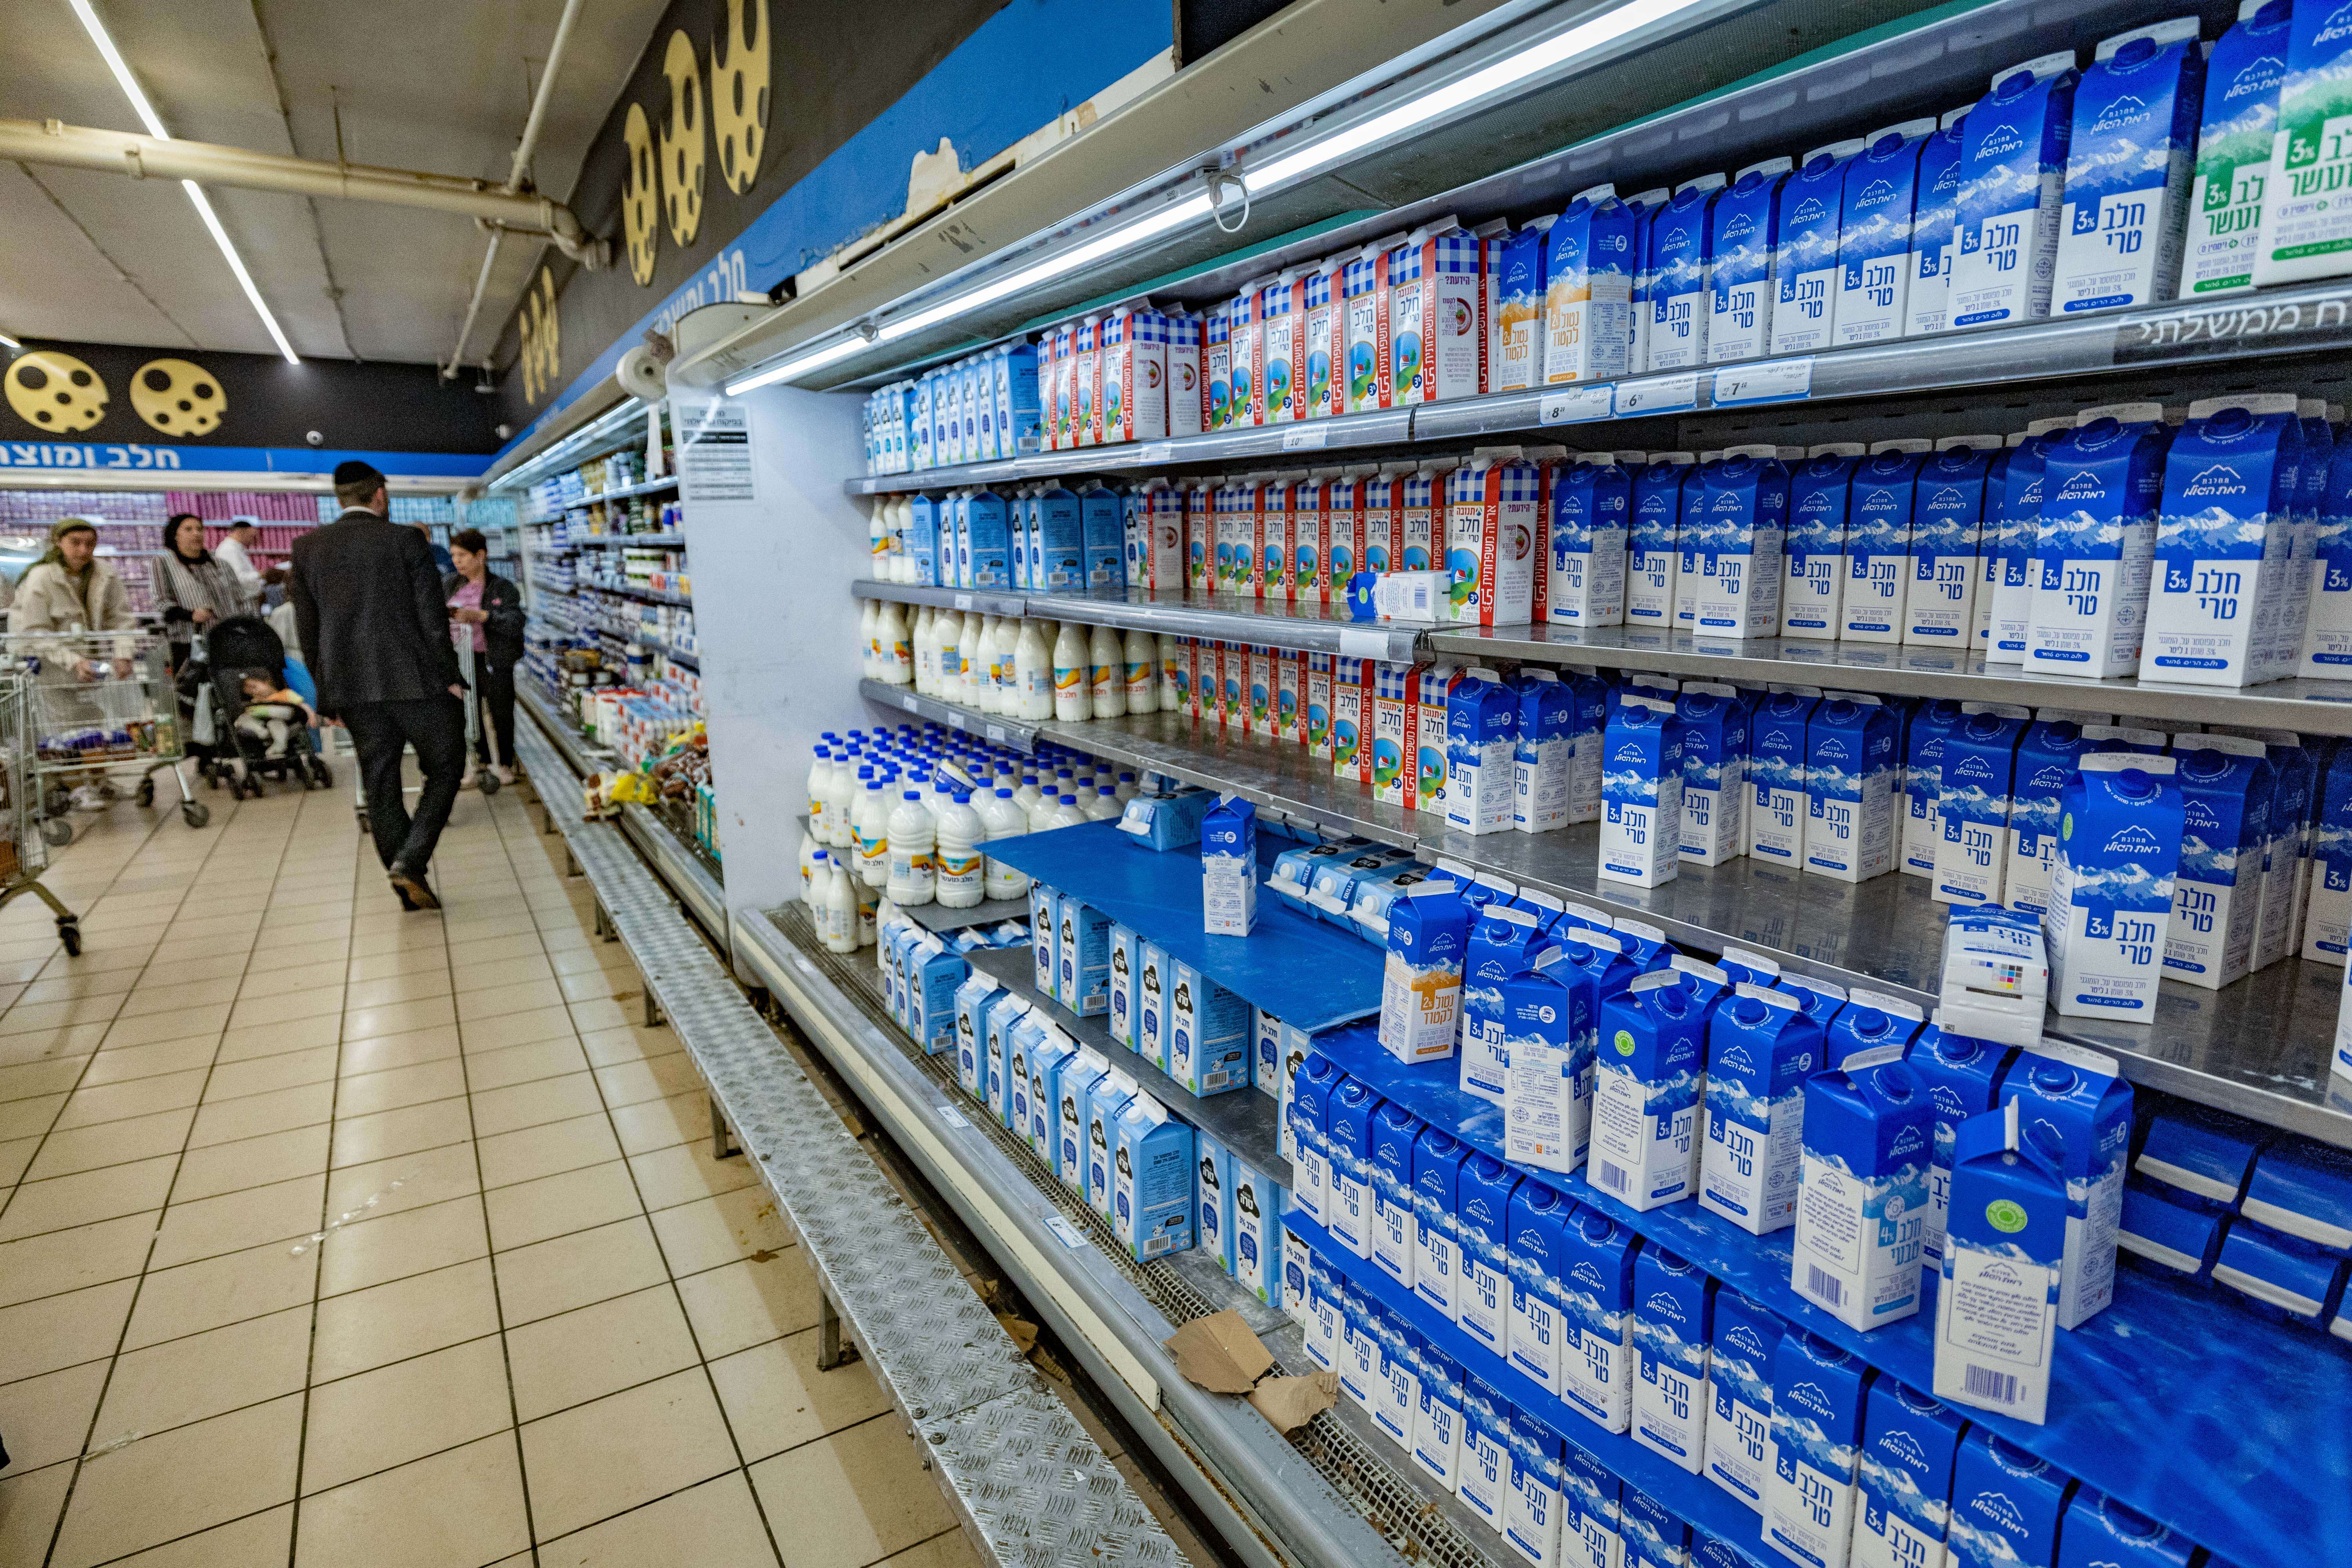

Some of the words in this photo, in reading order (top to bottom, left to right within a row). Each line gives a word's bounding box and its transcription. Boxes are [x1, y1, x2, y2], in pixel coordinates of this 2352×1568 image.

[2109, 107, 2134, 118] מחלבת
[2123, 112, 2151, 127] רמת
[2091, 118, 2123, 134] הגולן
[1989, 135, 2009, 145] מחלבת
[2000, 140, 2023, 153] רמת
[1975, 147, 1999, 162] הגולן
[2290, 138, 2315, 163] 3%
[2207, 183, 2227, 205] 3%
[2235, 175, 2264, 205] לב
[1855, 198, 1876, 210] הגולן
[1877, 194, 1896, 203] רמת
[2077, 210, 2094, 230] 3%
[2102, 203, 2145, 230] חלב
[2206, 205, 2261, 236] ועשר
[1964, 232, 1978, 250] 3%
[1984, 224, 2019, 250] חלב
[2106, 230, 2142, 254] טרי
[1987, 249, 2016, 271] טרי
[1445, 276, 1470, 285] הידעת?
[1847, 271, 1860, 287] 3%
[1865, 265, 1895, 288] חלב
[1398, 285, 1414, 298] תנובה
[1425, 277, 1434, 310] אריזה
[1868, 287, 1893, 307] טרי
[1401, 296, 1419, 316] חלב
[1717, 296, 1727, 310] 3%
[1731, 291, 1755, 311] חלב
[1410, 313, 1419, 323] טרי
[1552, 314, 1559, 327] 2%
[1561, 311, 1579, 328] נטול
[1733, 311, 1753, 328] טרי
[2139, 301, 2303, 344] ממשלתי
[1425, 311, 1434, 365] משפחתית
[1504, 331, 1510, 342] 2%
[1512, 329, 1528, 344] נטול
[1553, 327, 1579, 347] לקטוז
[1505, 343, 1527, 361] לקטוז
[1414, 376, 1421, 386] 3%
[1424, 367, 1435, 385] 1.5
[1732, 383, 1740, 395] 7
[1629, 395, 1637, 407] 6
[1552, 408, 1559, 418] 8
[104, 444, 180, 470] חלב
[2183, 485, 2215, 497] הגולן
[2216, 485, 2246, 495] רמת
[1407, 510, 1424, 519] תנובה
[1508, 504, 1530, 512] הידעת?
[1410, 519, 1428, 532] חלב
[1459, 516, 1479, 532] חלב
[1486, 505, 1496, 533] אריזה
[1468, 534, 1479, 543] טרי
[1483, 536, 1494, 586] משפחתית
[1705, 560, 1715, 573] 3%
[1719, 560, 1741, 577] חלב
[1855, 563, 1866, 575] 3%
[1870, 562, 1896, 579] חלב
[1920, 564, 1931, 577] 3%
[1936, 563, 1964, 581] חלב
[1720, 579, 1739, 593] טרי
[2169, 570, 2187, 588] 3%
[2195, 569, 2241, 594] חלב
[1481, 588, 1493, 605] 1.5
[1873, 582, 1894, 597] טרי
[1939, 584, 1963, 599] טרי
[1470, 594, 1477, 602] 3%
[2200, 598, 2237, 619] טרי
[2217, 638, 2230, 646] חלב
[1379, 702, 1396, 711] תנובה
[1381, 711, 1401, 726] חלב
[1391, 727, 1401, 735] טרי
[1610, 808, 1619, 820] 3%
[1623, 810, 1646, 828] חלב
[1626, 828, 1645, 844] טרי
[1947, 825, 1959, 839] 3%
[1964, 829, 1992, 849] חלב
[2103, 842, 2133, 852] הגולן
[2134, 845, 2160, 853] רמת
[1967, 848, 1991, 866] טרי
[2090, 918, 2109, 935] 3%
[2116, 919, 2155, 943] חלב
[2120, 945, 2152, 965] טרי
[1423, 997, 1432, 1008] 2%
[1436, 995, 1454, 1013] נטול
[1425, 1007, 1453, 1025] לקטוז
[1719, 1056, 1739, 1069] הגולן
[1730, 1054, 1746, 1063] מחלבת
[1738, 1065, 1755, 1076] רמת
[1712, 1121, 1722, 1139] 3%
[1727, 1130, 1753, 1159] חלב
[1730, 1151, 1752, 1176] טרי
[1240, 1191, 1253, 1210] טרה
[1239, 1216, 1245, 1227] 3%
[1247, 1221, 1256, 1234] חלב
[1880, 1227, 1894, 1243] 4%
[1899, 1217, 1922, 1243] חלב
[1891, 1239, 1920, 1266] טבעי
[1642, 1362, 1655, 1382] 3%
[1659, 1368, 1690, 1402] חלב
[1663, 1392, 1688, 1419] טרי
